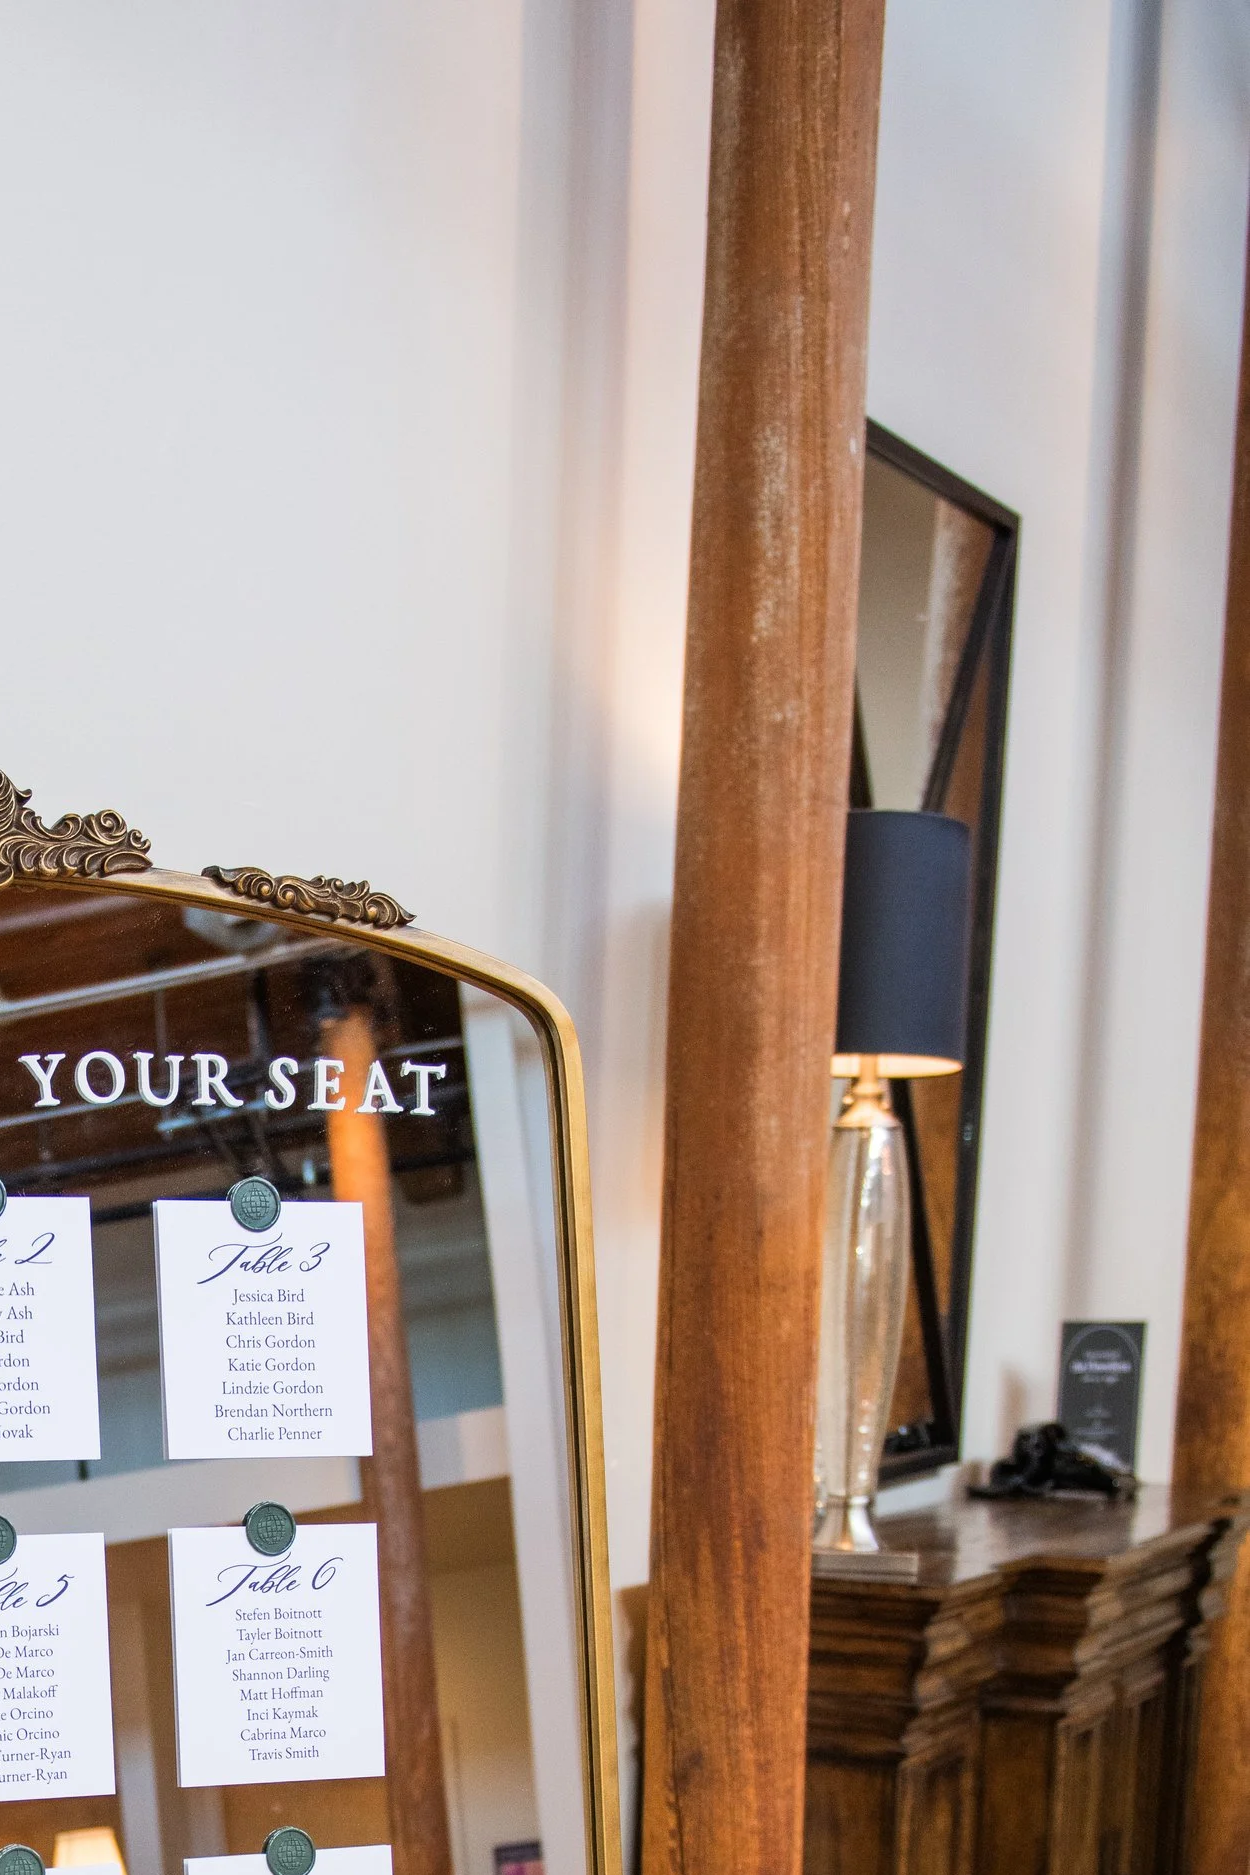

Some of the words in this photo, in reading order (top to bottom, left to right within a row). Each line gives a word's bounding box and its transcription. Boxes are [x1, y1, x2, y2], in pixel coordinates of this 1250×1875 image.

[18, 1050, 245, 1108] YOUR
[263, 1056, 447, 1116] SEAT
[14, 1231, 56, 1265] 2
[196, 1232, 294, 1285] Table
[298, 1241, 331, 1273] 3
[8, 1281, 35, 1297] Ash
[225, 1311, 283, 1326] Kathleen
[286, 1311, 314, 1326] Bird
[225, 1334, 262, 1349] Chris
[264, 1334, 316, 1349] Gordon
[227, 1426, 275, 1441] Charlie
[278, 1426, 323, 1441] Penner
[205, 1552, 302, 1607] Table
[311, 1556, 344, 1591] 6
[35, 1573, 75, 1608] 5
[11, 1623, 60, 1641] Bojarski
[236, 1627, 272, 1646] Tayler
[274, 1627, 323, 1640] Boitnott
[232, 1668, 284, 1682] Shannon
[286, 1665, 330, 1683] Darling
[2, 1684, 59, 1700] Malakoff
[16, 1727, 60, 1741] Orcino
[248, 1748, 283, 1761] Travis
[285, 1745, 320, 1760] Smith
